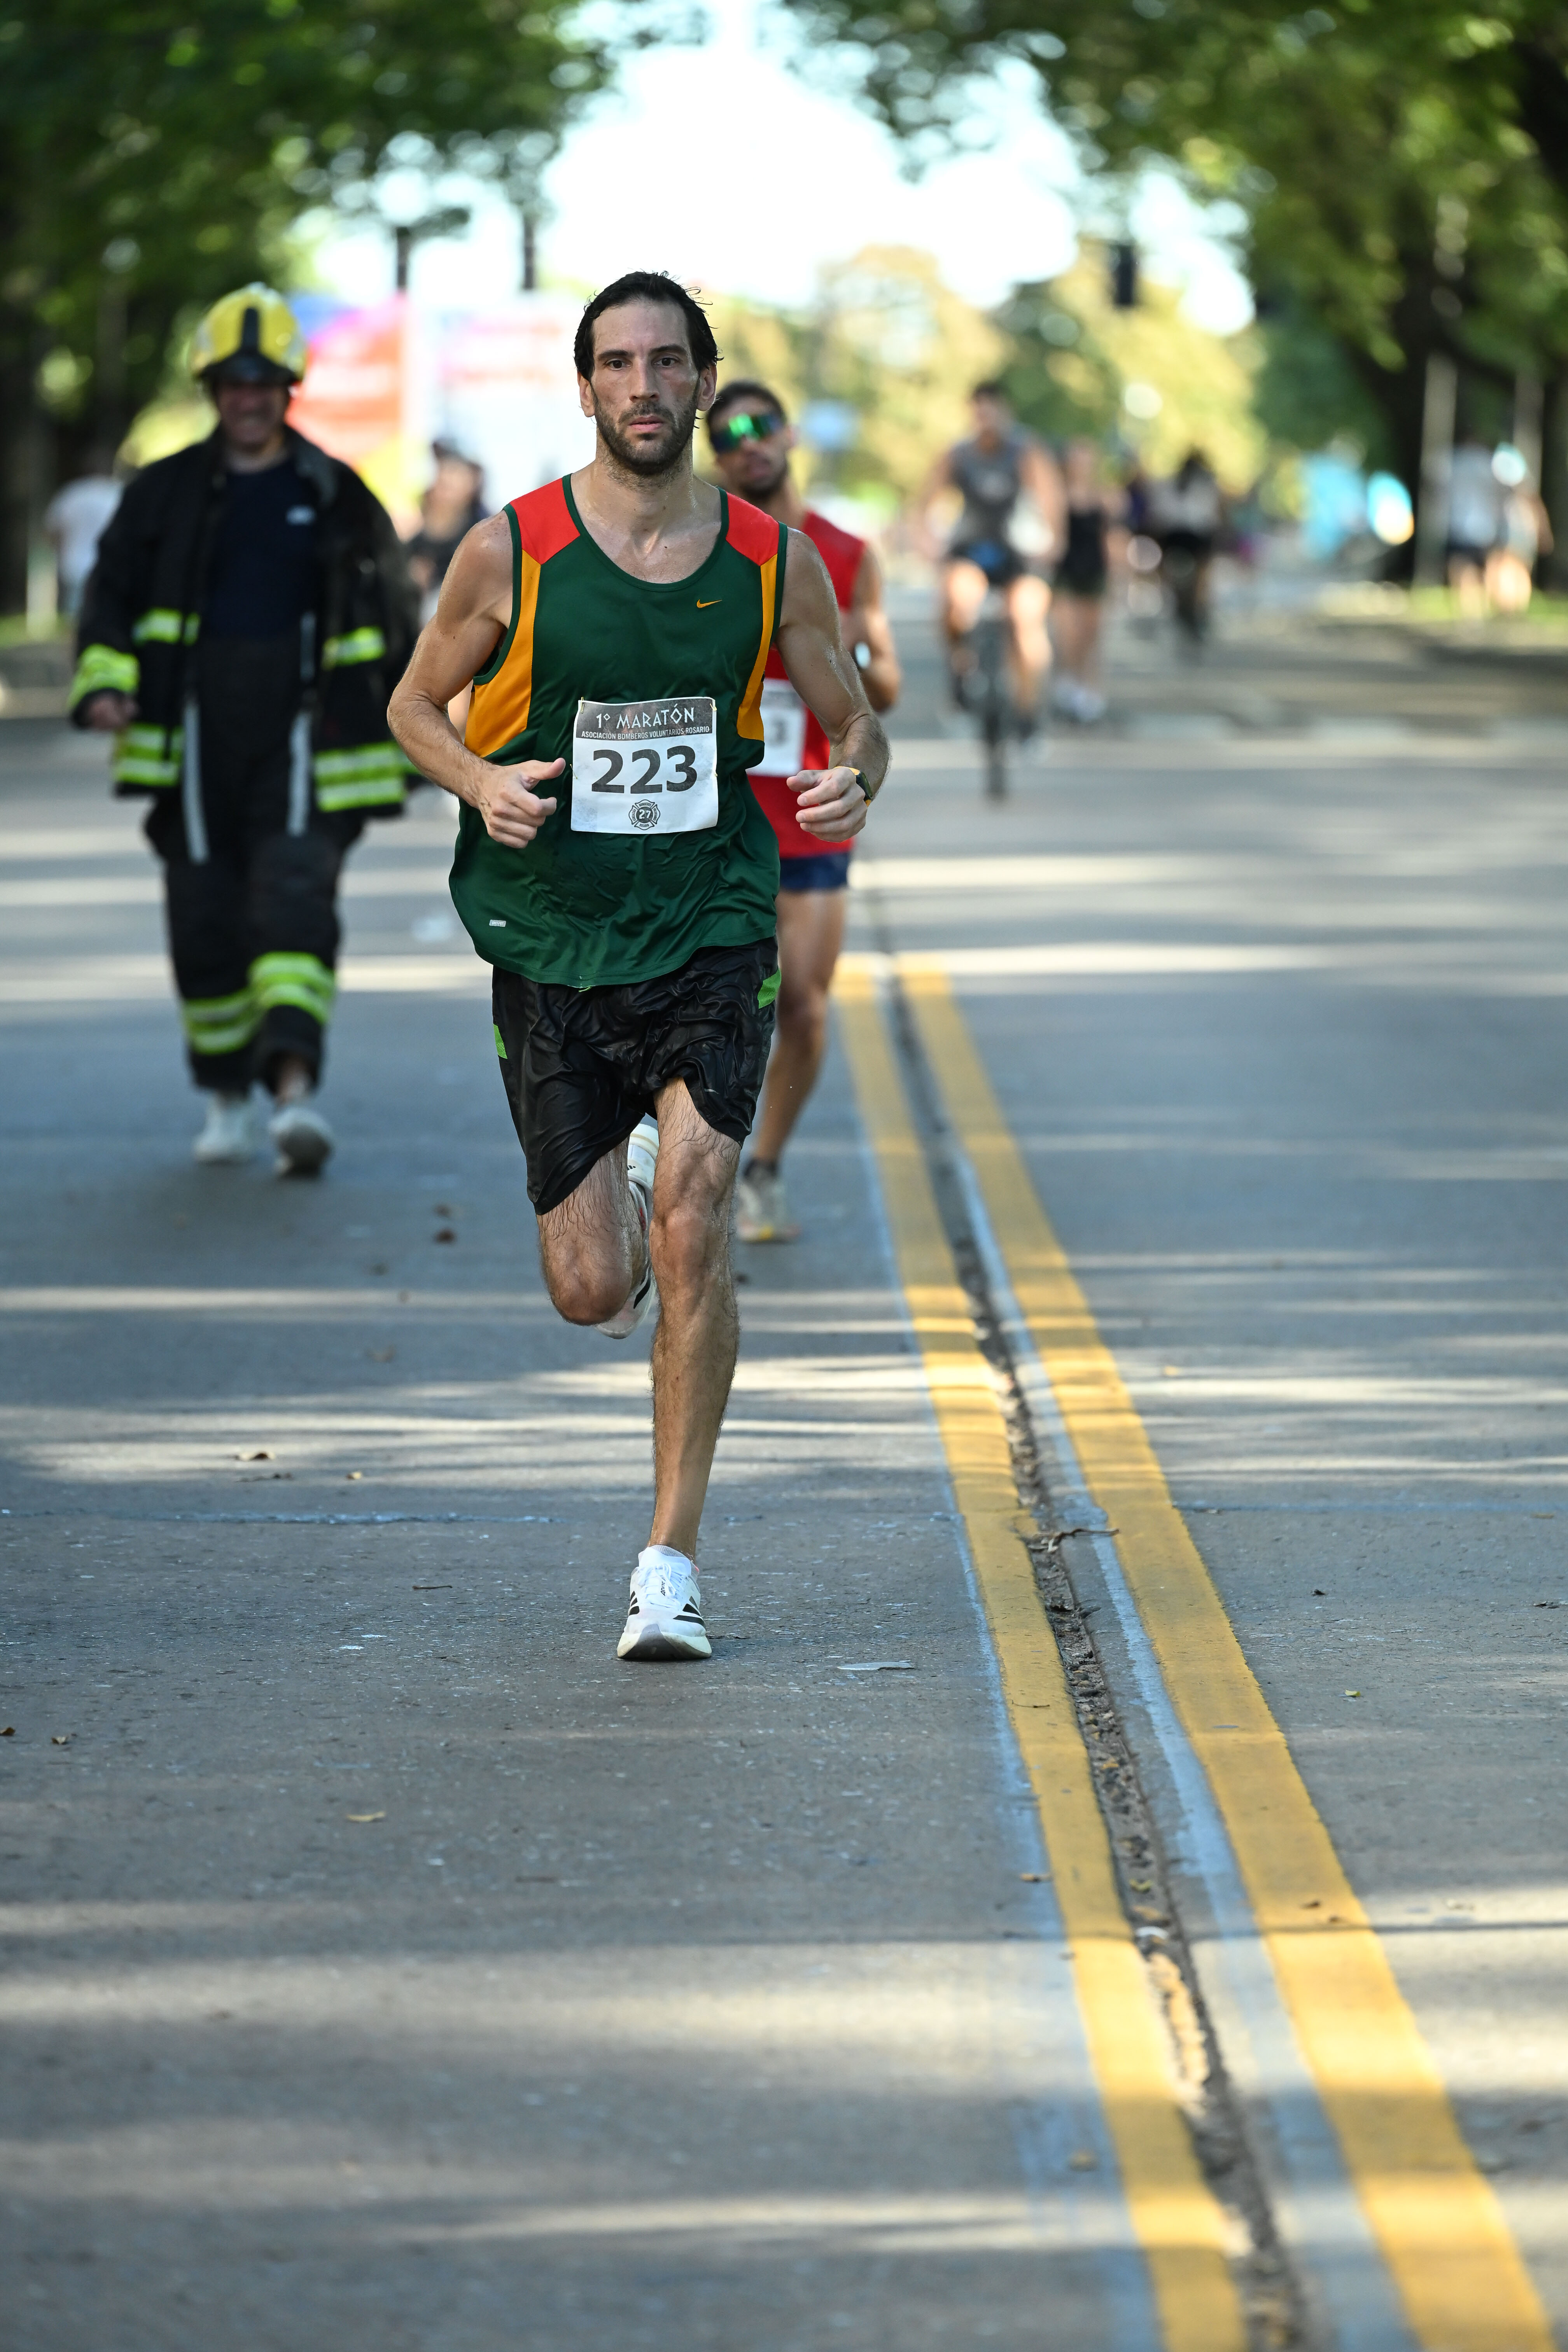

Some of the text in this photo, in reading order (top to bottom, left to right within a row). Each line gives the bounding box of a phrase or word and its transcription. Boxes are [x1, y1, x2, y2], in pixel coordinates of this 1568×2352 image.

[616, 704, 694, 729] MARATÓN
[649, 728, 684, 738] VOLUNTARIOS
[592, 746, 697, 794] 223
[639, 809, 651, 819] 27
